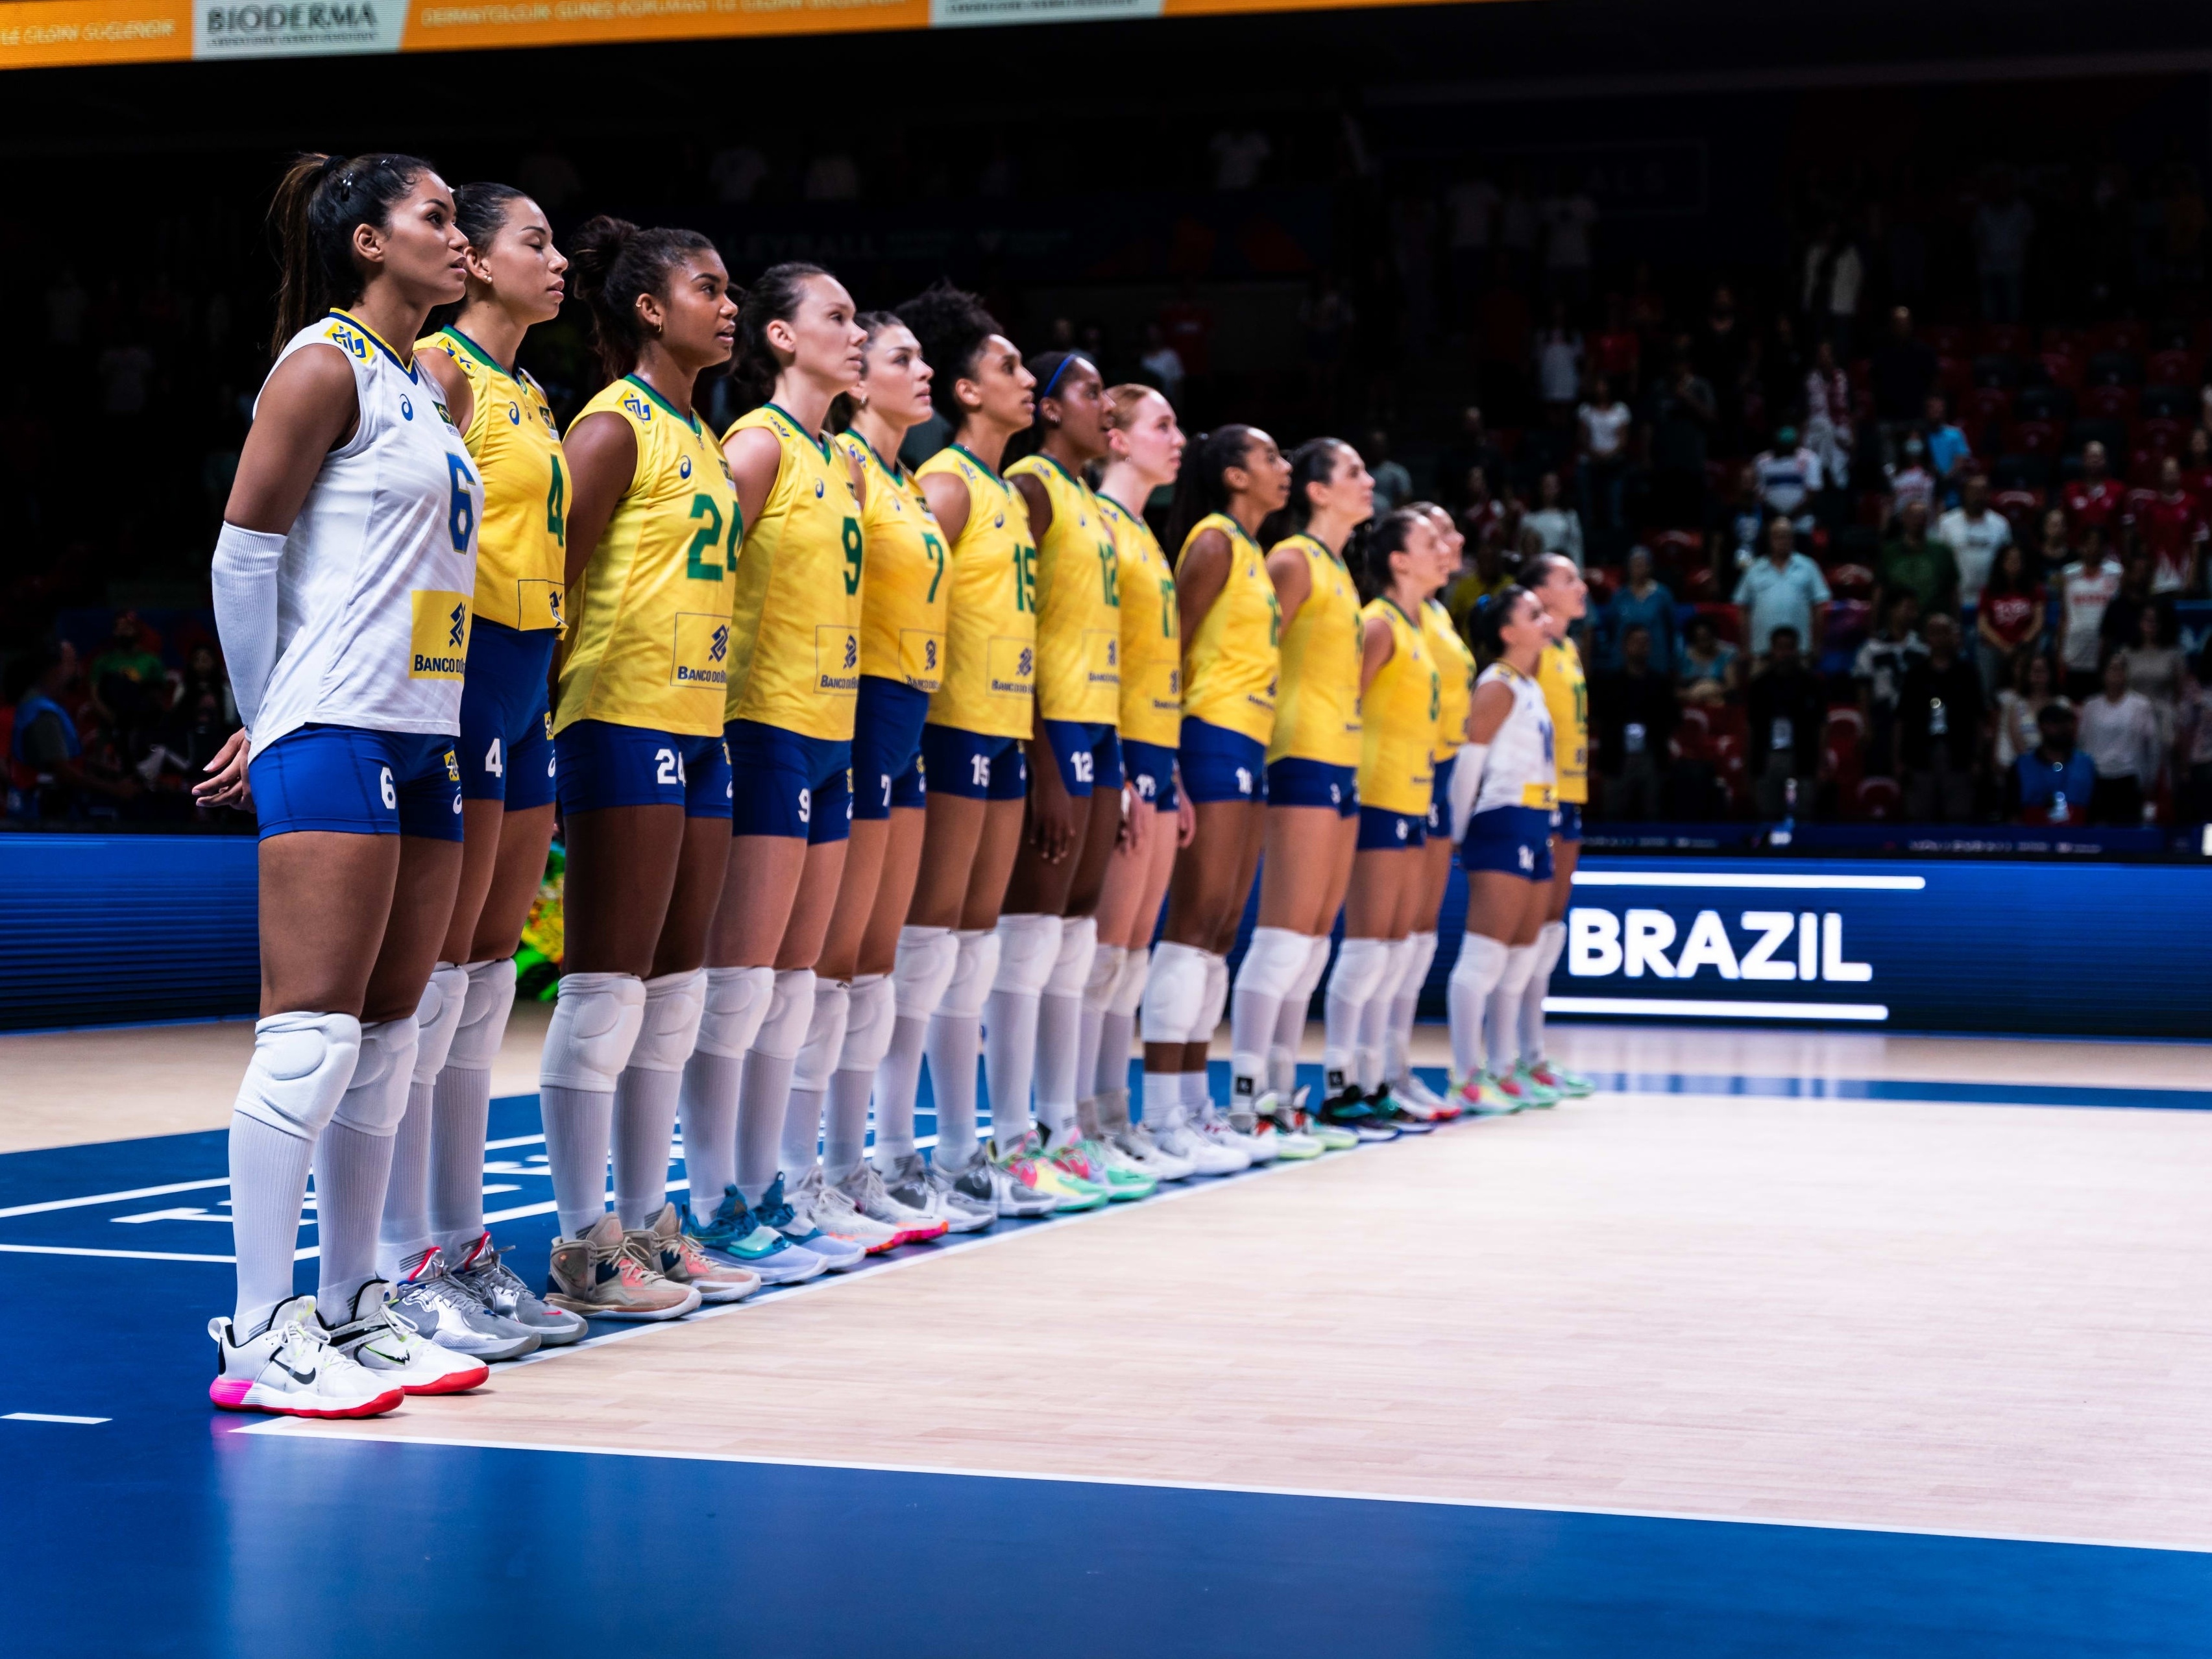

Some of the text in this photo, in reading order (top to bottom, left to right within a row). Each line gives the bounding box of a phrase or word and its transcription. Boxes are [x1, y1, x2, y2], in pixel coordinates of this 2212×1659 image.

[206, 2, 378, 32] BIODERMA
[446, 451, 476, 555] 6
[546, 454, 565, 547] 4
[842, 516, 863, 595] 9
[921, 532, 944, 604] 7
[414, 654, 454, 673] BANCO
[677, 666, 711, 682] BANCO
[485, 738, 502, 778] 4
[971, 754, 990, 787] 15
[1071, 751, 1094, 782] 12
[380, 767, 396, 810] 6
[798, 788, 811, 823] 9
[881, 774, 892, 807] 7
[1568, 908, 1873, 982] BRAZIL
